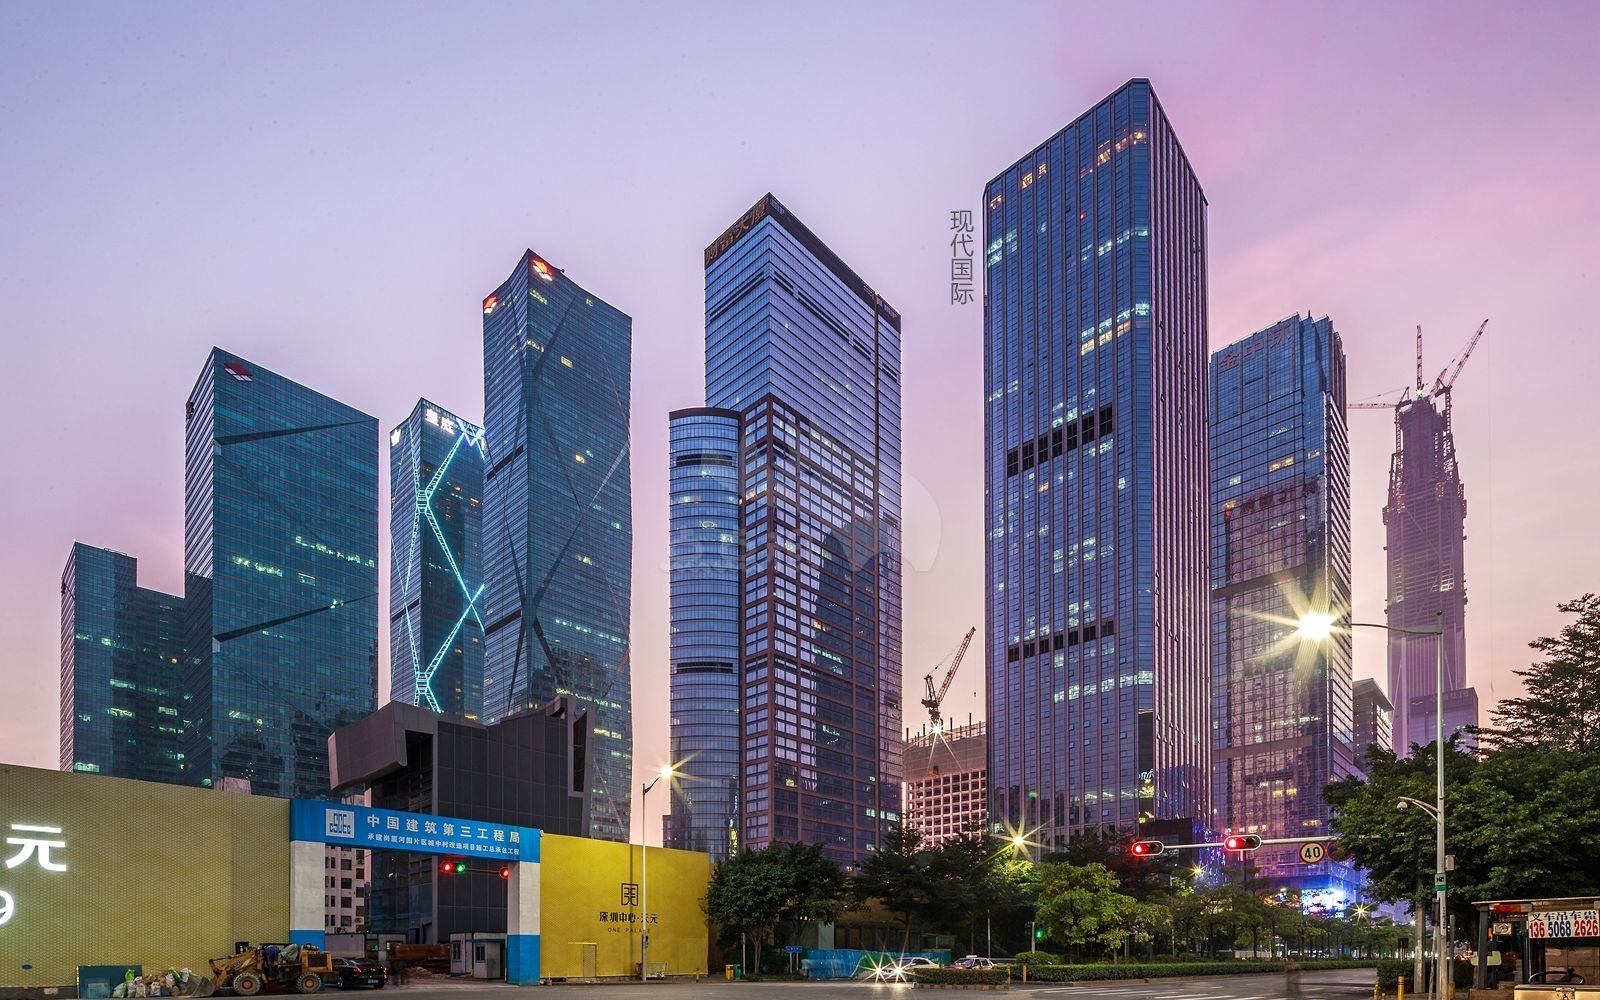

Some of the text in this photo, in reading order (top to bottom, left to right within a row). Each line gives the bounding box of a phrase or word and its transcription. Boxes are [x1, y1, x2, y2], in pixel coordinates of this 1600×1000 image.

[367, 813, 520, 844] 中国建筑第三工程局
[5, 824, 67, 872] 元
[1304, 846, 1320, 859] 40
[1530, 919, 1599, 938] 136 5068 2626
